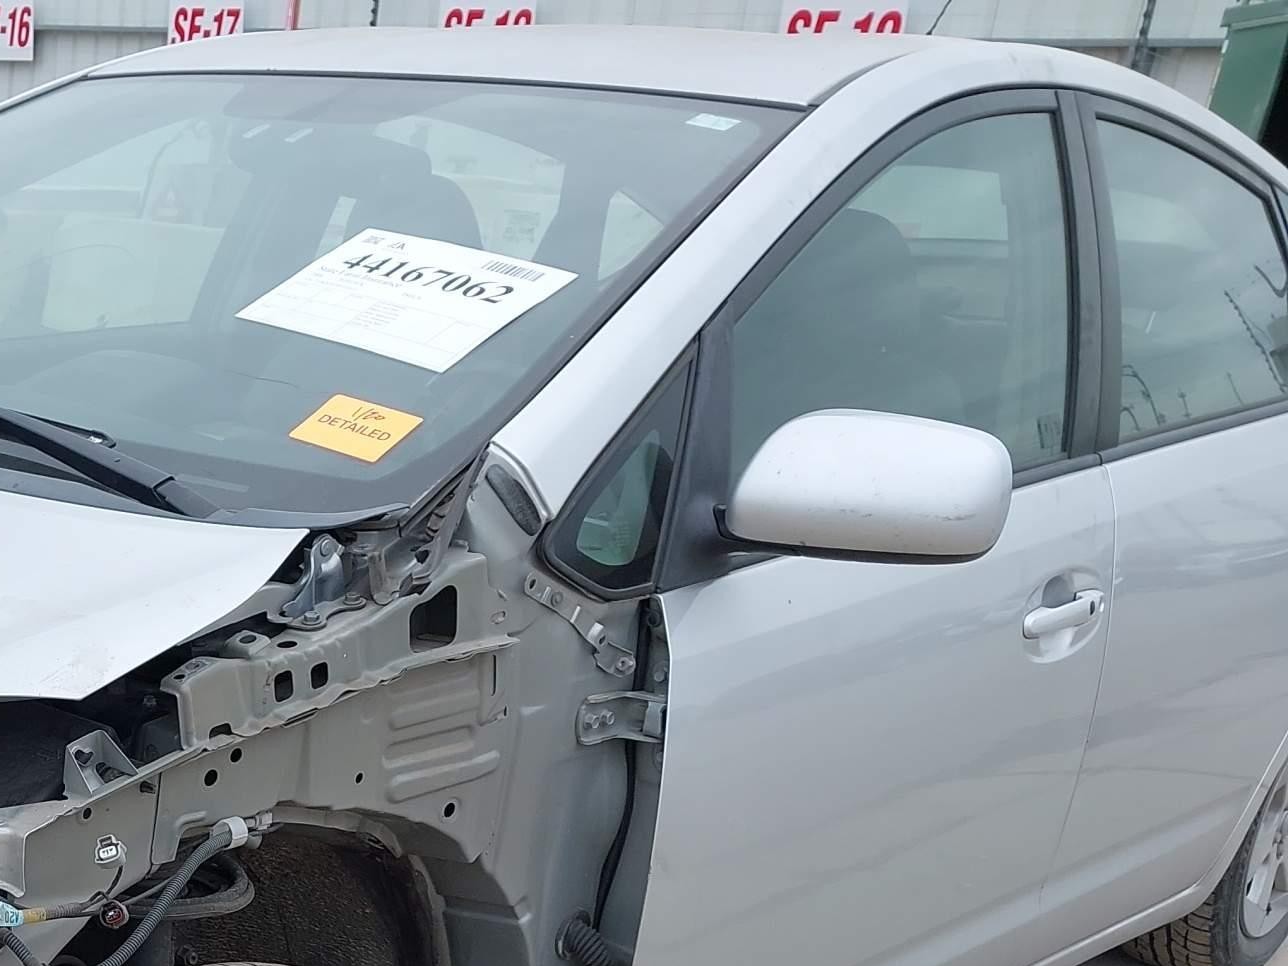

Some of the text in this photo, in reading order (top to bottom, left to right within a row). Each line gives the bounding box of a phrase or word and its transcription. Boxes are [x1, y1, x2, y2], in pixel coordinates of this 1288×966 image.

[171, 7, 240, 44] SF-17
[343, 253, 514, 304] 44167062
[317, 414, 391, 441] DETAILED
